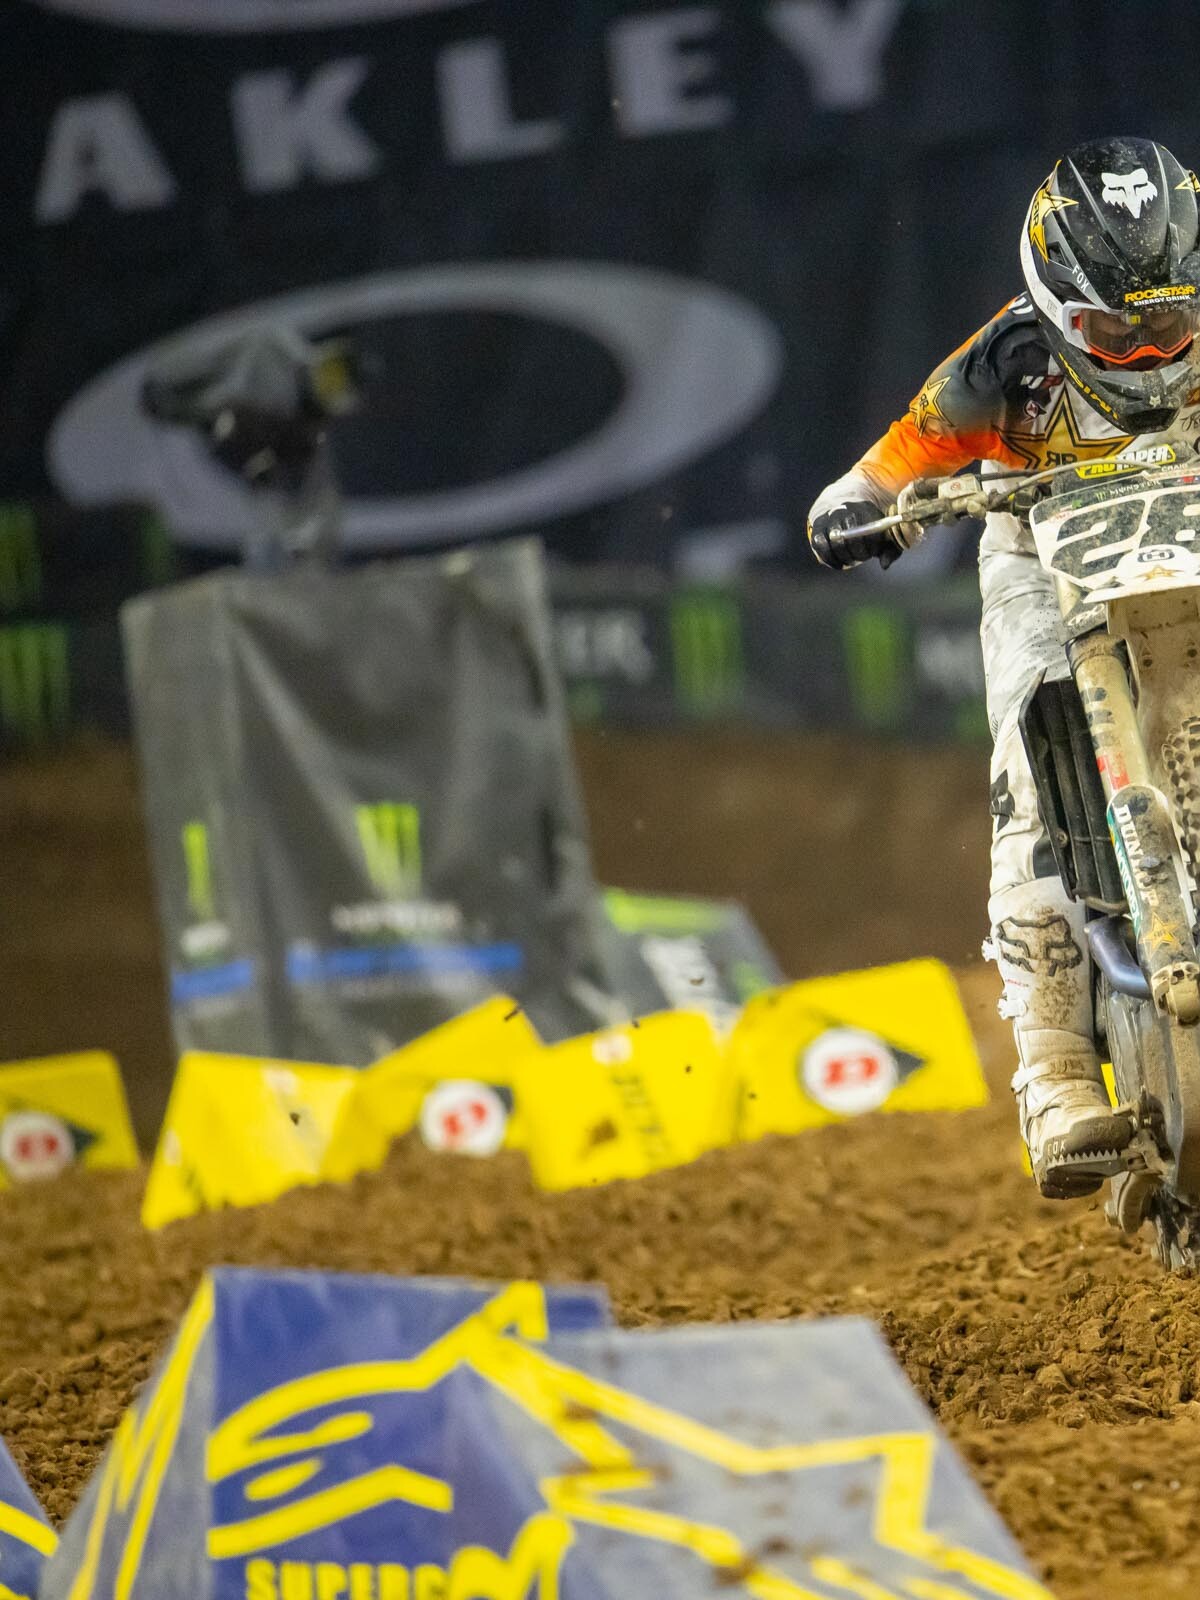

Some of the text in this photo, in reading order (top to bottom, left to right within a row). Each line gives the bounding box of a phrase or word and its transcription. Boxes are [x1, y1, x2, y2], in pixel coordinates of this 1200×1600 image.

[1072, 264, 1089, 293] FOX
[1124, 285, 1196, 303] ROCKSTAR
[1133, 294, 1192, 306] ENERGY DRINK
